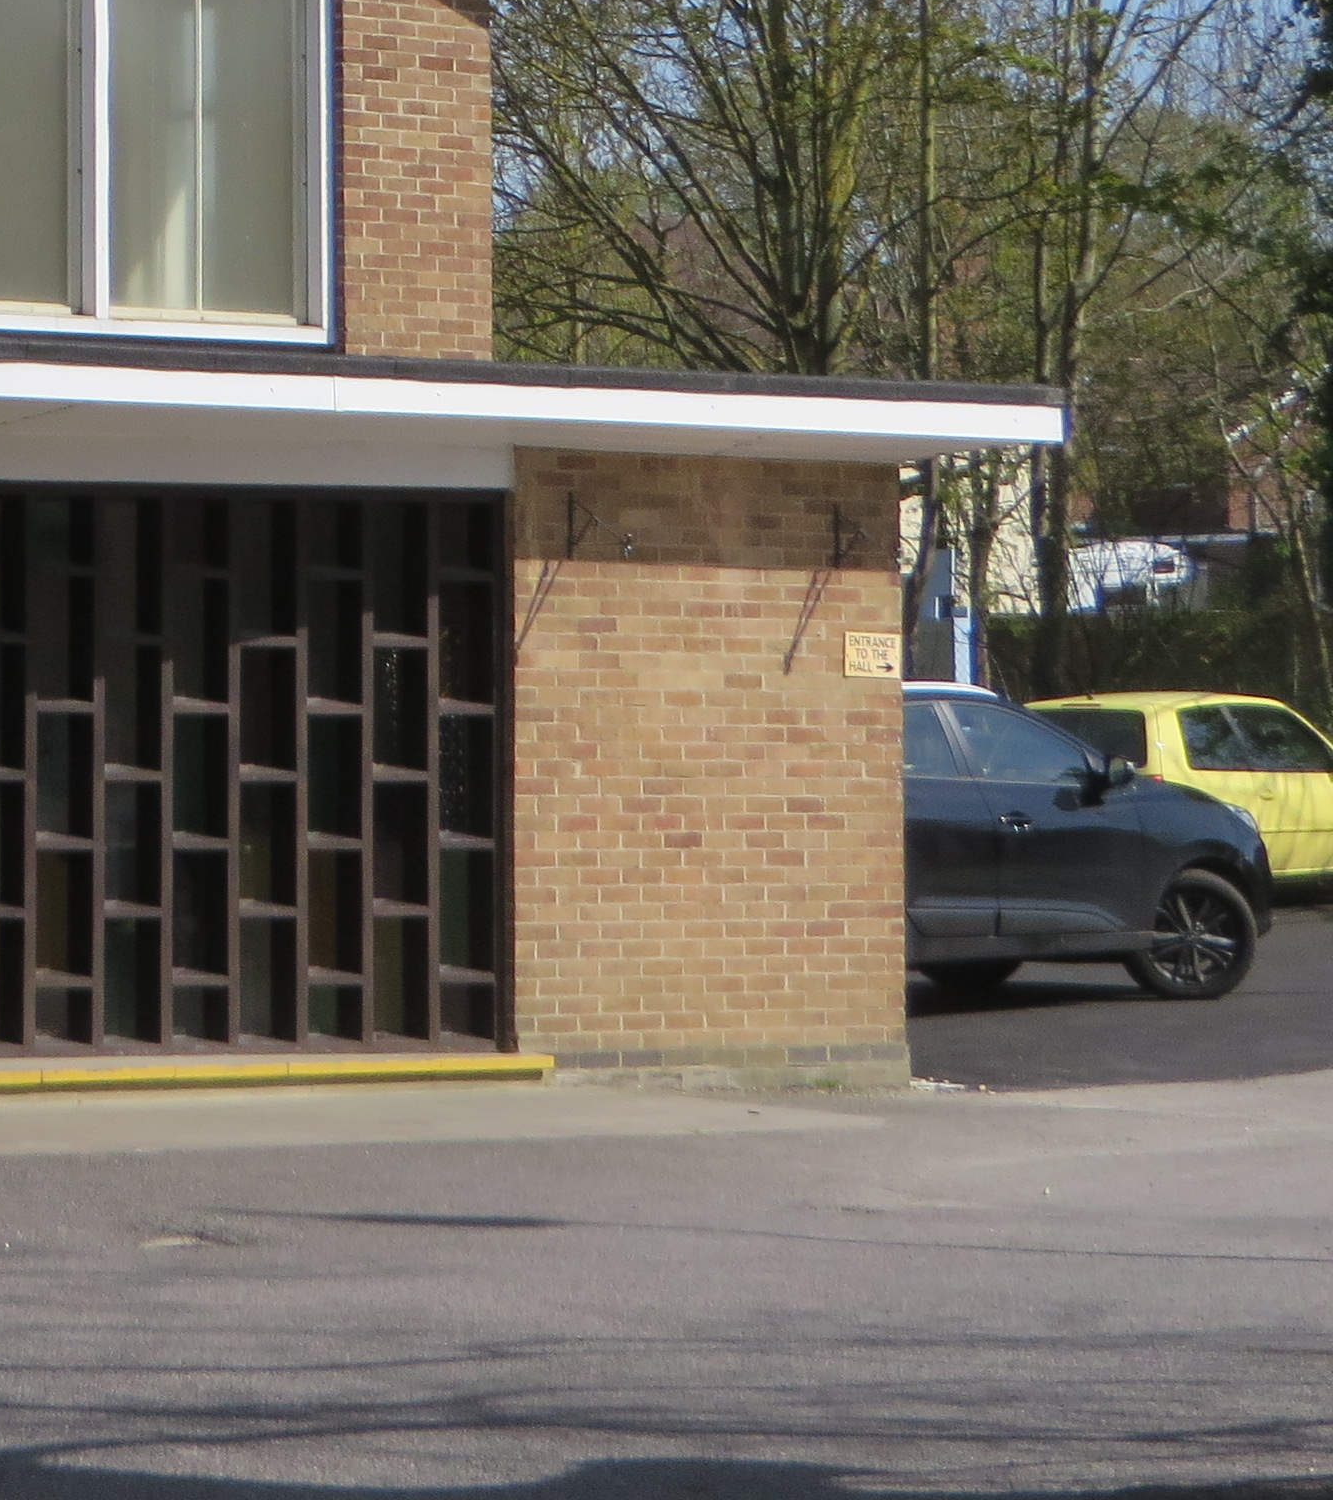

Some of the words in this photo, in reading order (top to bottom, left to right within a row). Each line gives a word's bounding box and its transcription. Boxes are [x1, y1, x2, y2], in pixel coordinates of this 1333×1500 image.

[848, 635, 896, 649] ENTRANCE
[855, 647, 868, 660] TO
[872, 648, 889, 661] THE
[848, 660, 873, 673] HALL
